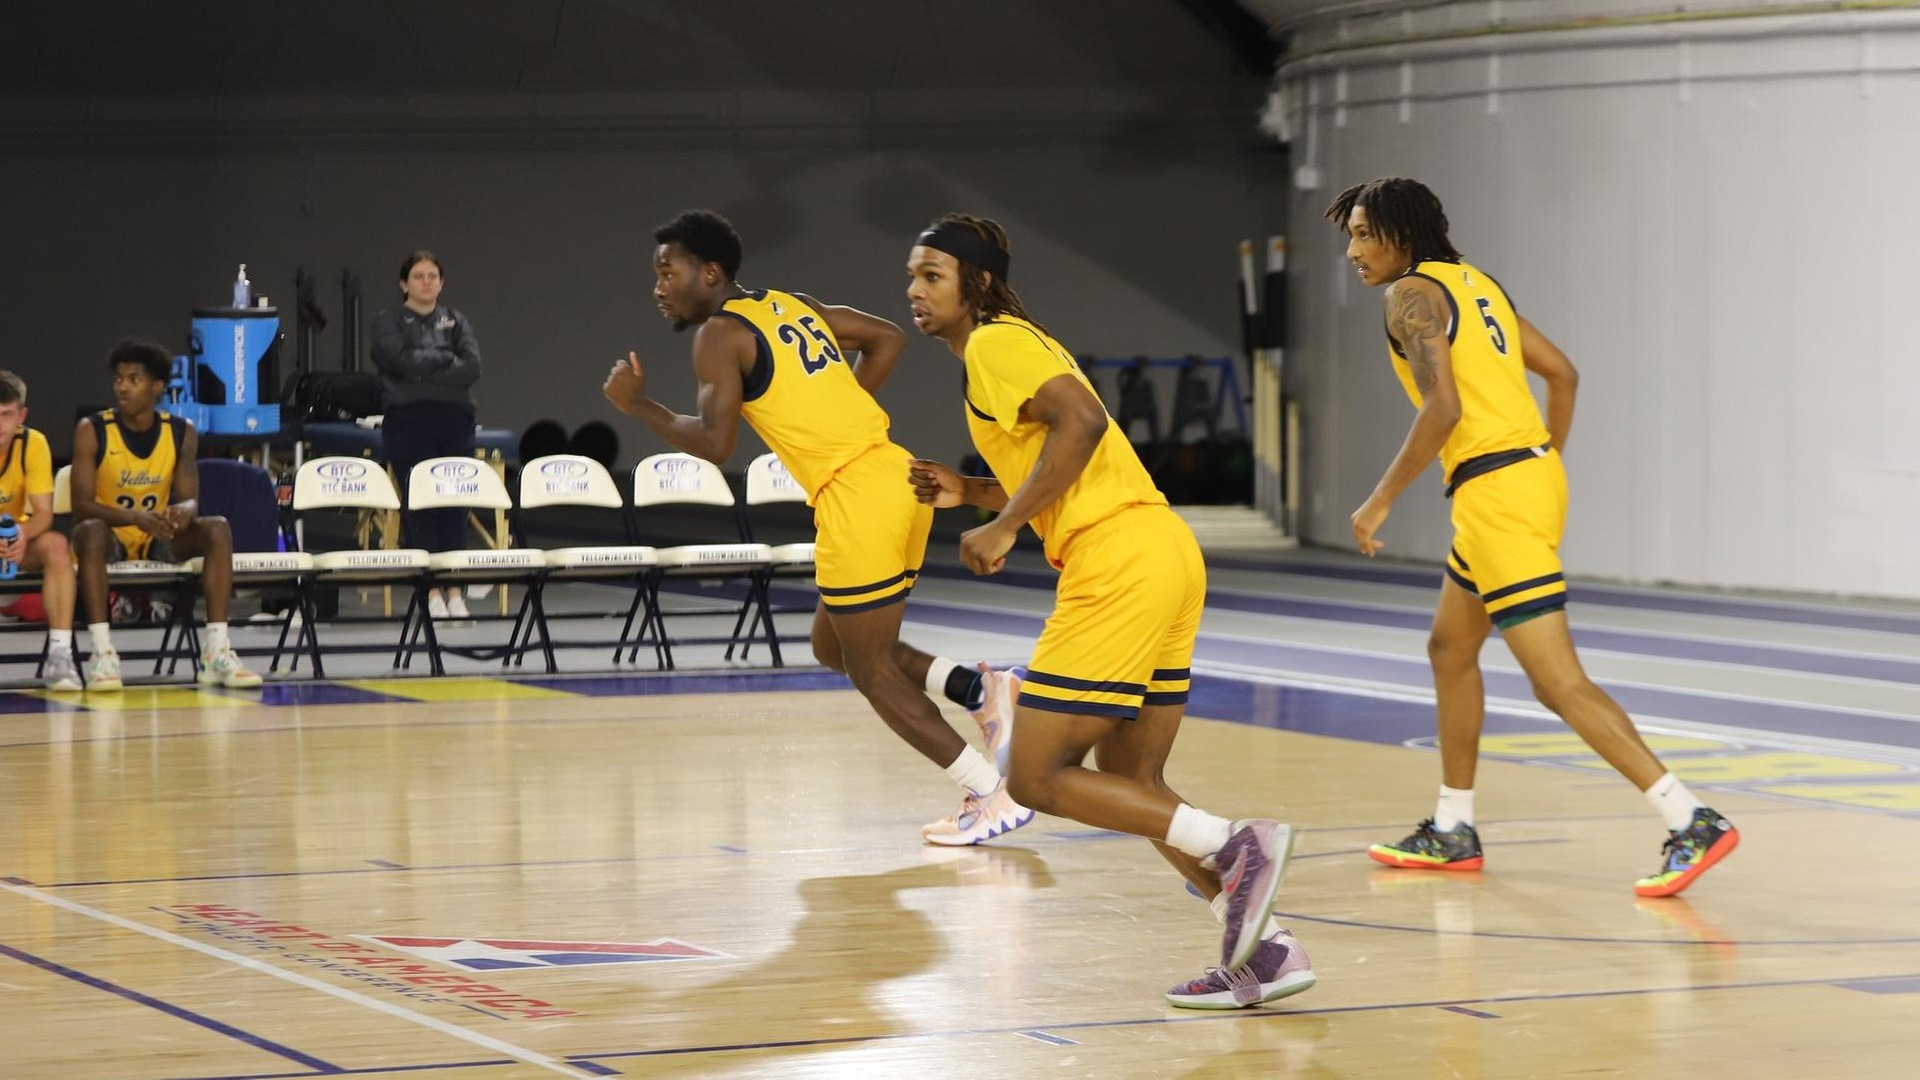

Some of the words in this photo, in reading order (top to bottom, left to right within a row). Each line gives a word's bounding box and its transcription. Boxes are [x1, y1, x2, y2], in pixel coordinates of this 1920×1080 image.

[1475, 297, 1508, 356] 5
[234, 324, 245, 404] POWERADE
[777, 315, 842, 376] 25
[331, 463, 354, 476] BTC
[341, 481, 367, 494] BANK
[347, 555, 413, 566] YELLOWJACKETS
[468, 554, 531, 565] YELLOWJACKETS
[168, 903, 333, 940] HEART
[175, 918, 288, 952] ATHLETIC
[282, 952, 455, 1004] CONFERENCE
[310, 942, 378, 954] OF
[335, 955, 577, 1020] AMERICA
